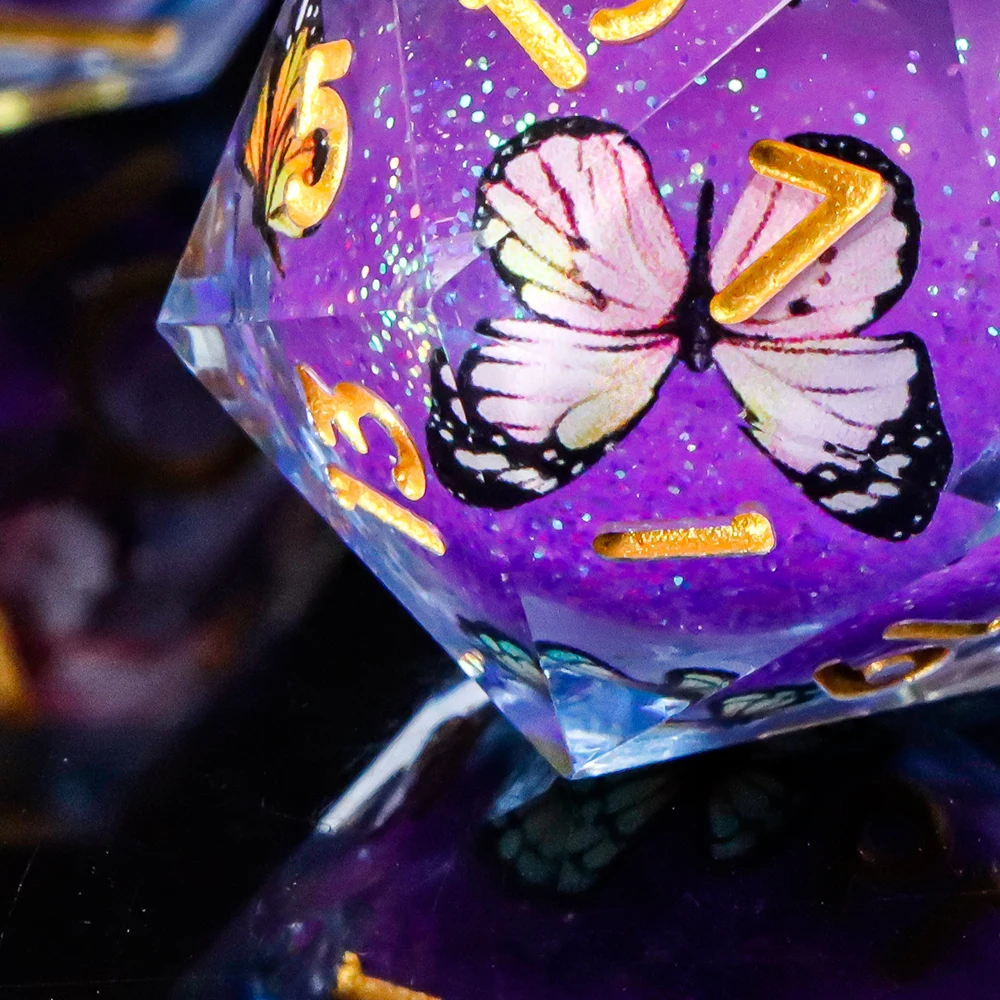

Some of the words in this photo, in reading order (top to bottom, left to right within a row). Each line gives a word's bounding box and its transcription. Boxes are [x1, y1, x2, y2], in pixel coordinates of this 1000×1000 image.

[285, 38, 353, 230] 5
[710, 139, 884, 324] 7
[296, 363, 446, 556] 13
[592, 512, 776, 560] 1
